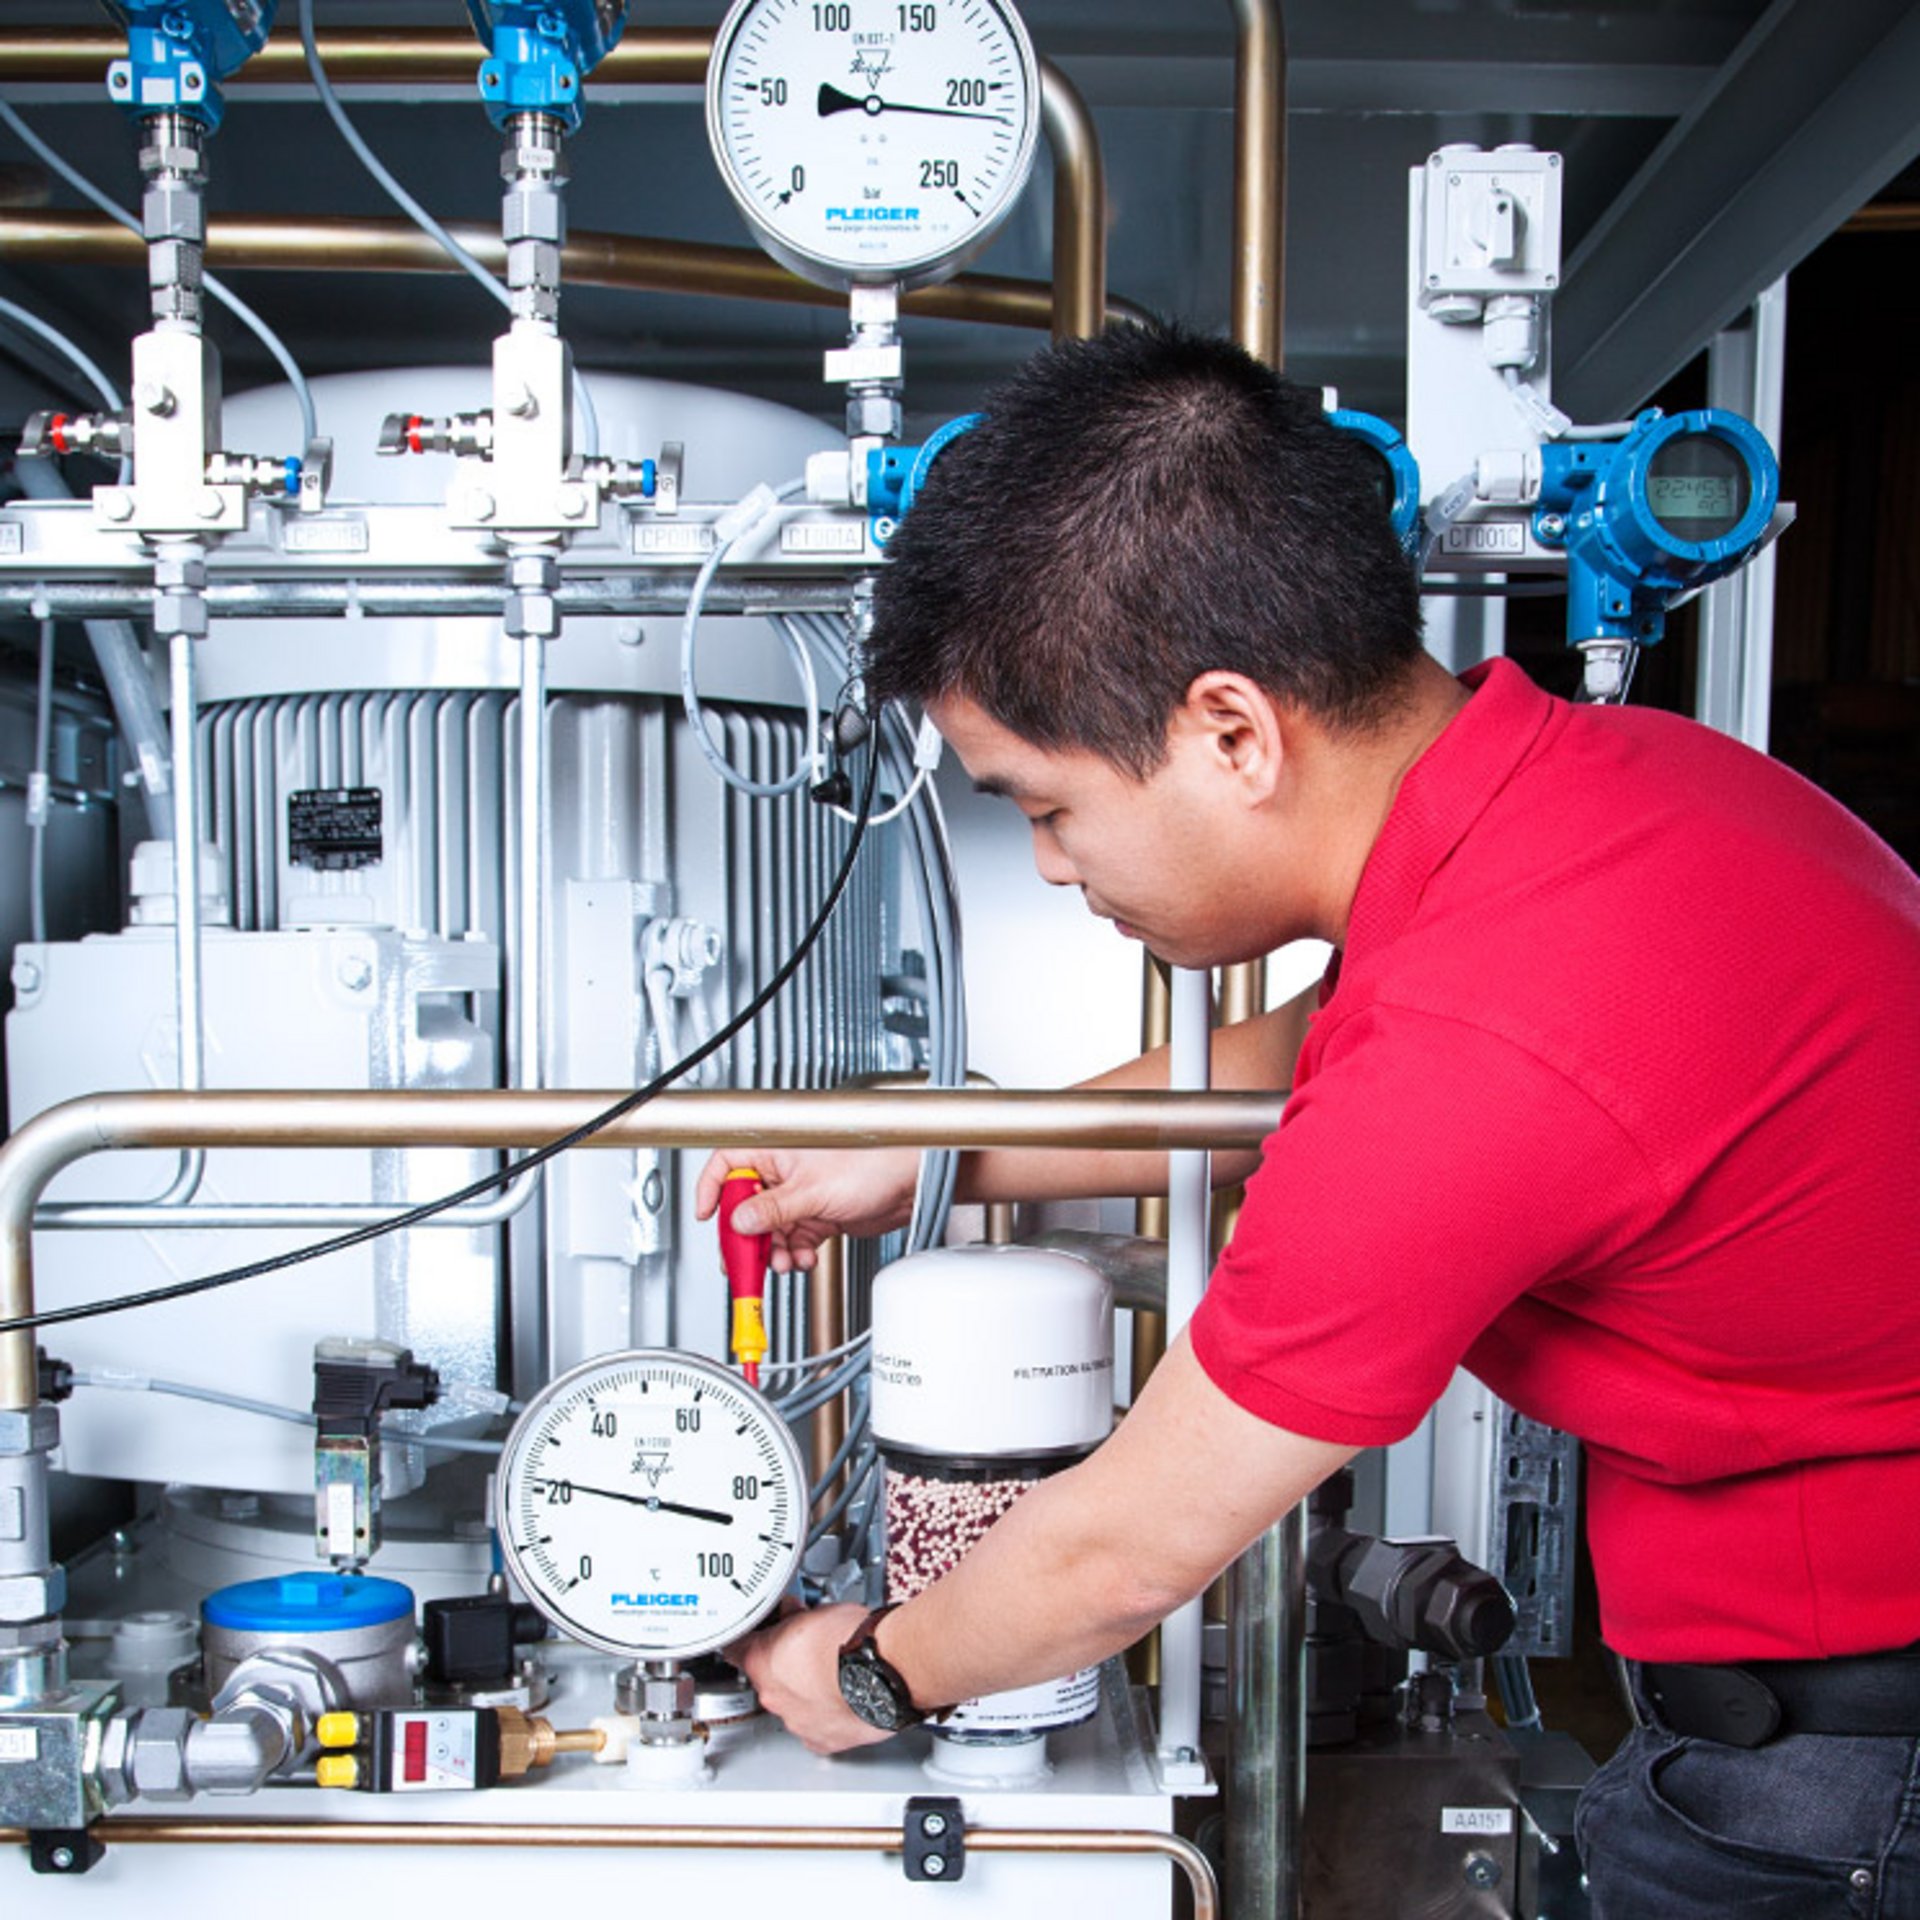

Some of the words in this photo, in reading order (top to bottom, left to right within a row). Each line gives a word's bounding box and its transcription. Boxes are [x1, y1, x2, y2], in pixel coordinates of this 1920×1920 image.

[812, 4, 850, 32] 100
[897, 4, 936, 32] 150
[760, 79, 788, 107] 50
[946, 79, 986, 107] 200
[791, 165, 805, 193] 0
[919, 160, 958, 189] 250
[863, 186, 882, 200] bar
[825, 207, 920, 221] PLEIGER
[1449, 526, 1519, 548] CT001C
[591, 1413, 617, 1438] 40
[676, 1408, 701, 1432] 60
[547, 1481, 572, 1505] 20
[733, 1475, 758, 1500] 80
[579, 1555, 592, 1580] 0
[697, 1552, 734, 1578] 100
[611, 1593, 699, 1607] PLEIGER
[1455, 1811, 1502, 1830] AA151
